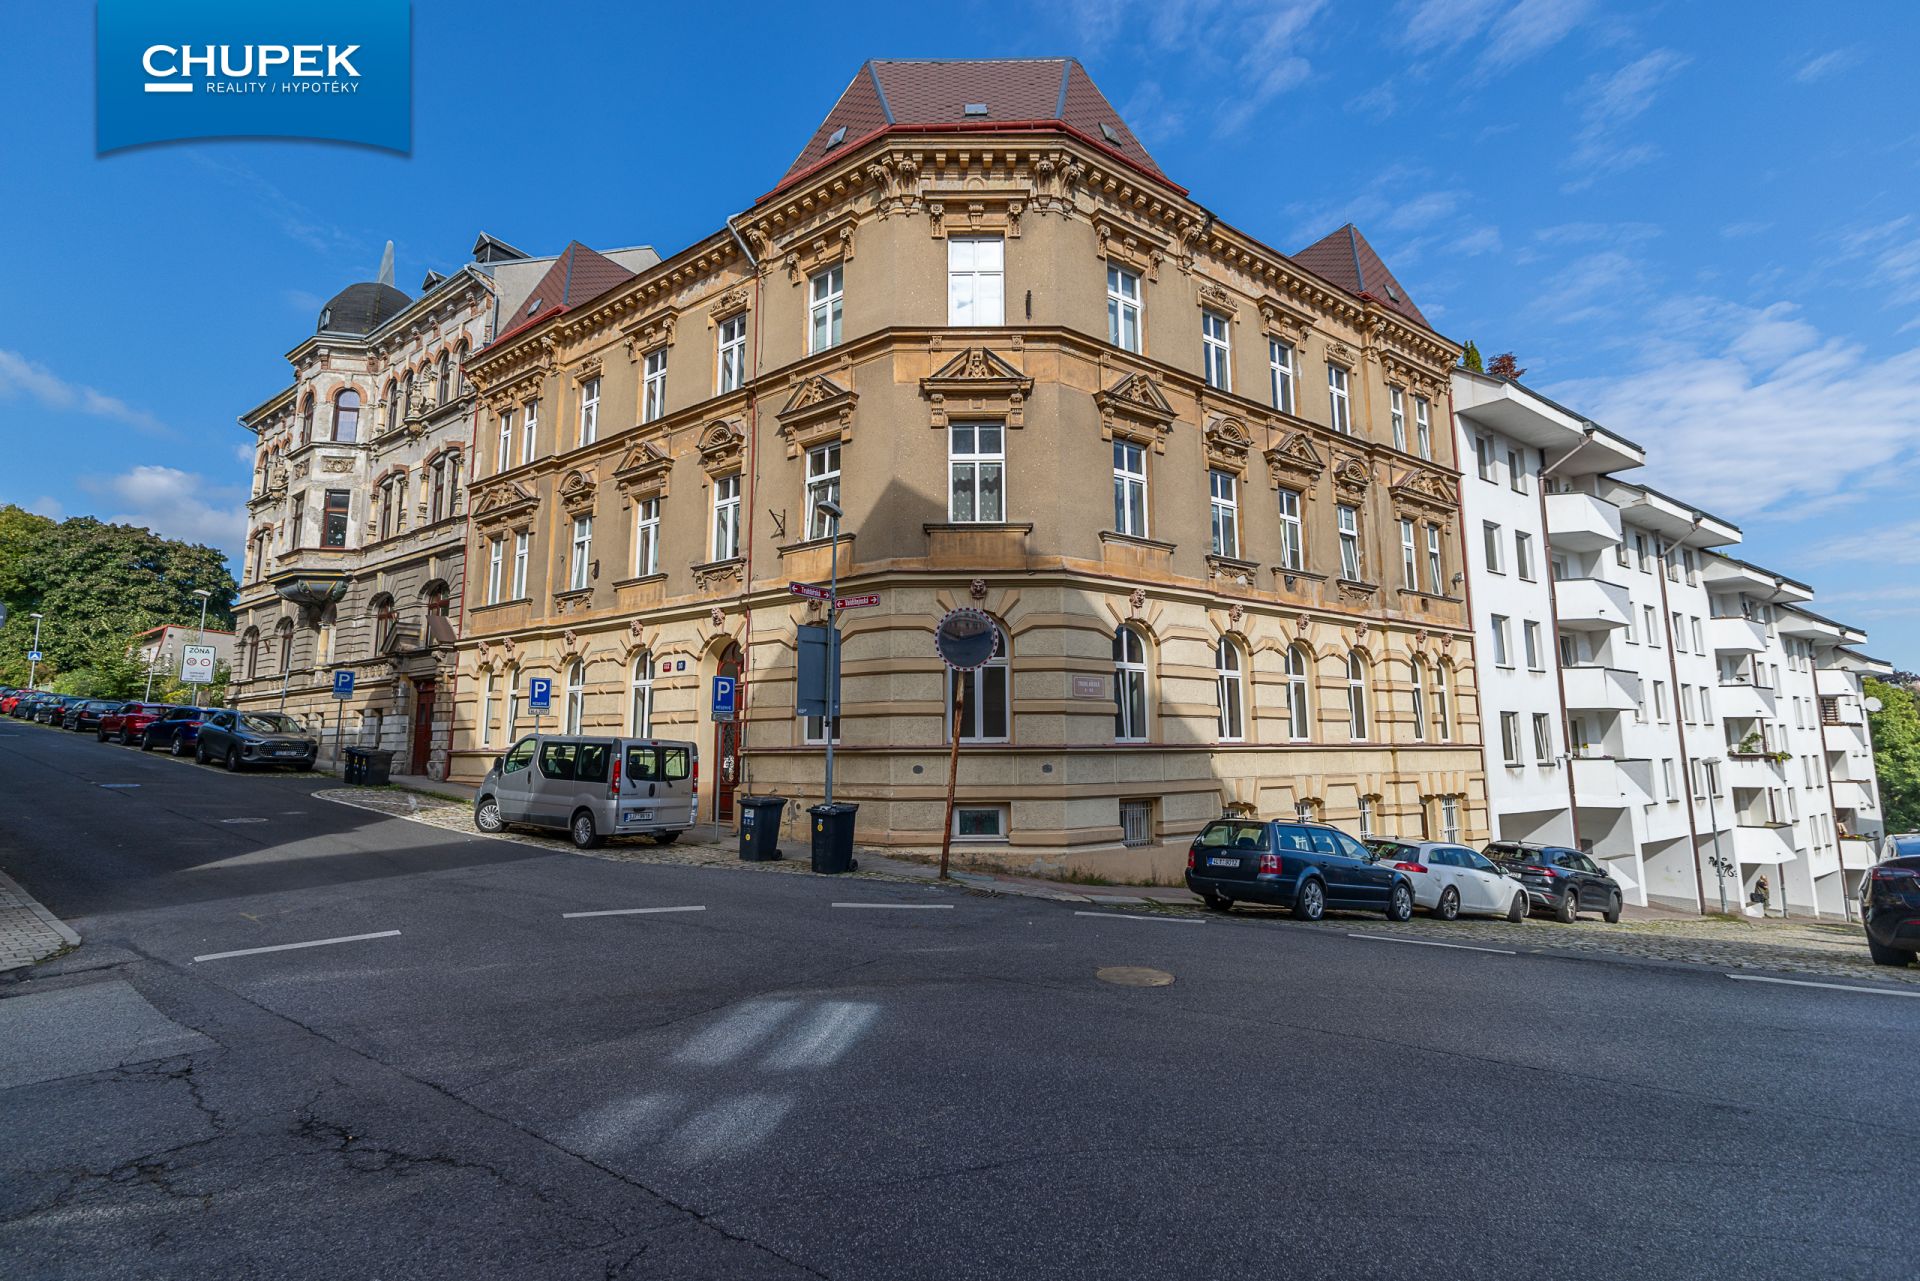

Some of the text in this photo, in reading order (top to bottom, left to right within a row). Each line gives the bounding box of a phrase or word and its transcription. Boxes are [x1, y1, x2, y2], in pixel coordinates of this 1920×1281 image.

[338, 673, 350, 686] P
[534, 681, 547, 698] P
[717, 681, 730, 701] P
